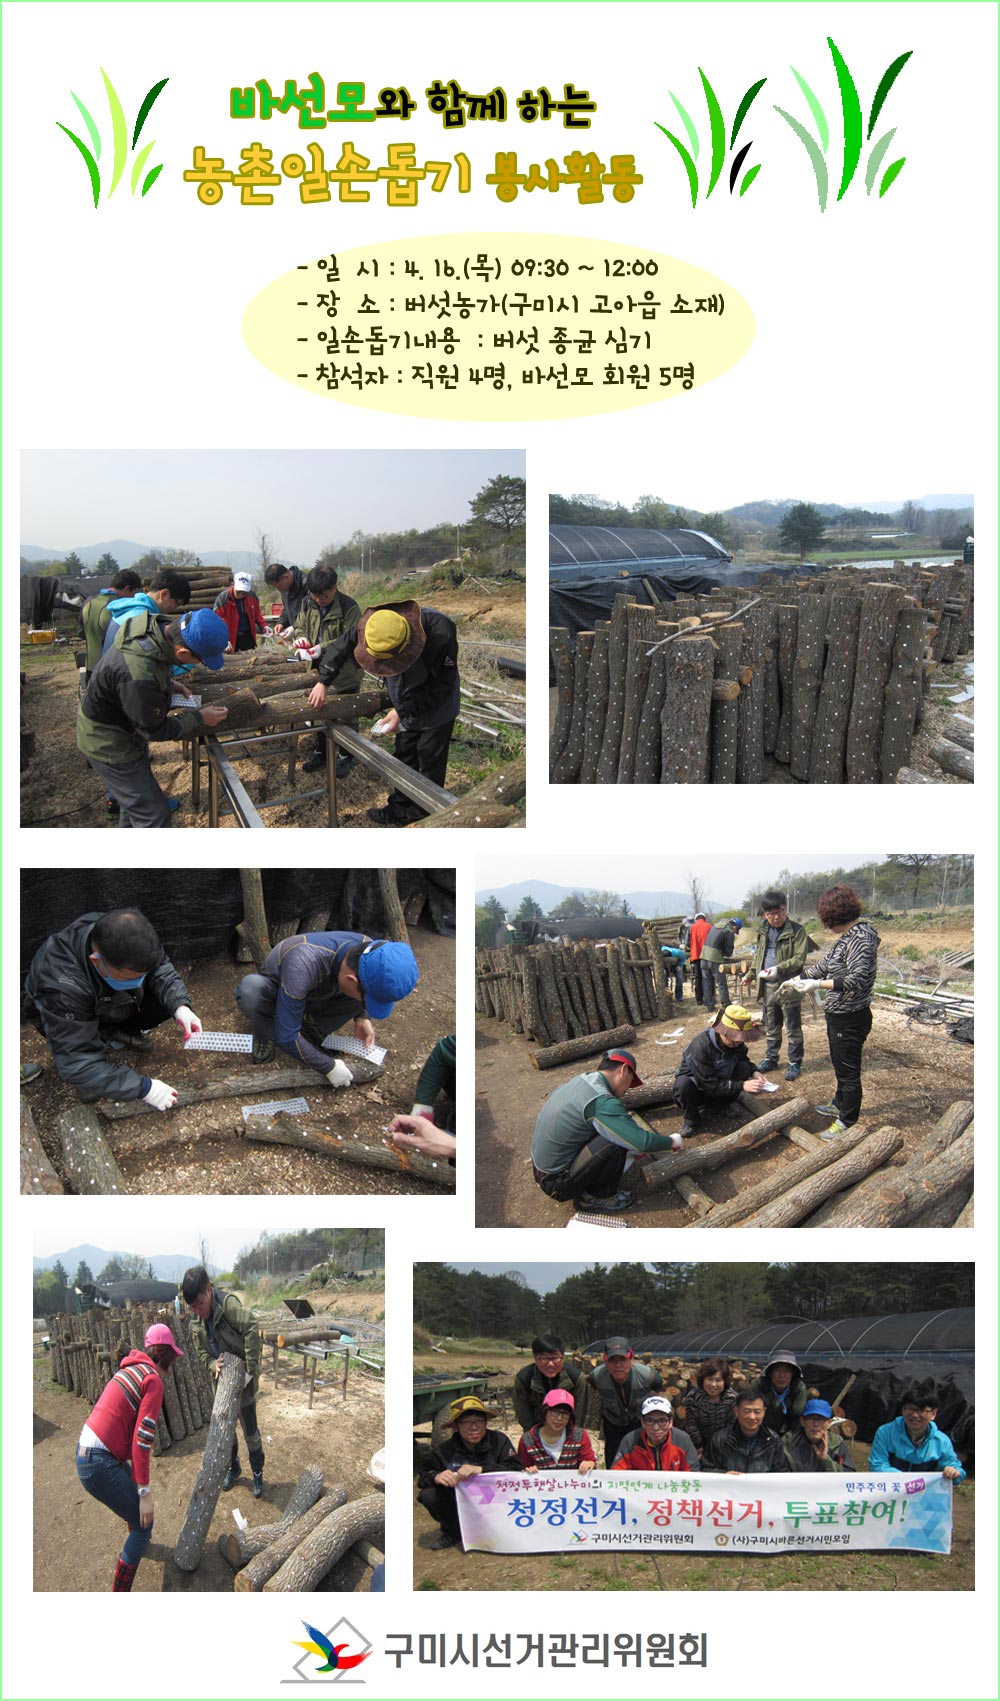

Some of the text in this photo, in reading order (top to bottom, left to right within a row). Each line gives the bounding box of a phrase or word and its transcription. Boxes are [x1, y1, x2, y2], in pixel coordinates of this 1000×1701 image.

[607, 1479, 654, 1492] 지역연계
[657, 1479, 703, 1494] 나눔활동
[845, 1480, 925, 1493] 민주주의 꽃 선거
[507, 1497, 908, 1529] 청정선거, 정책선거, 투표참여!
[591, 1533, 694, 1545] 구미시선거관리위원회
[731, 1534, 851, 1546] (사)구미시바른선거시민모임
